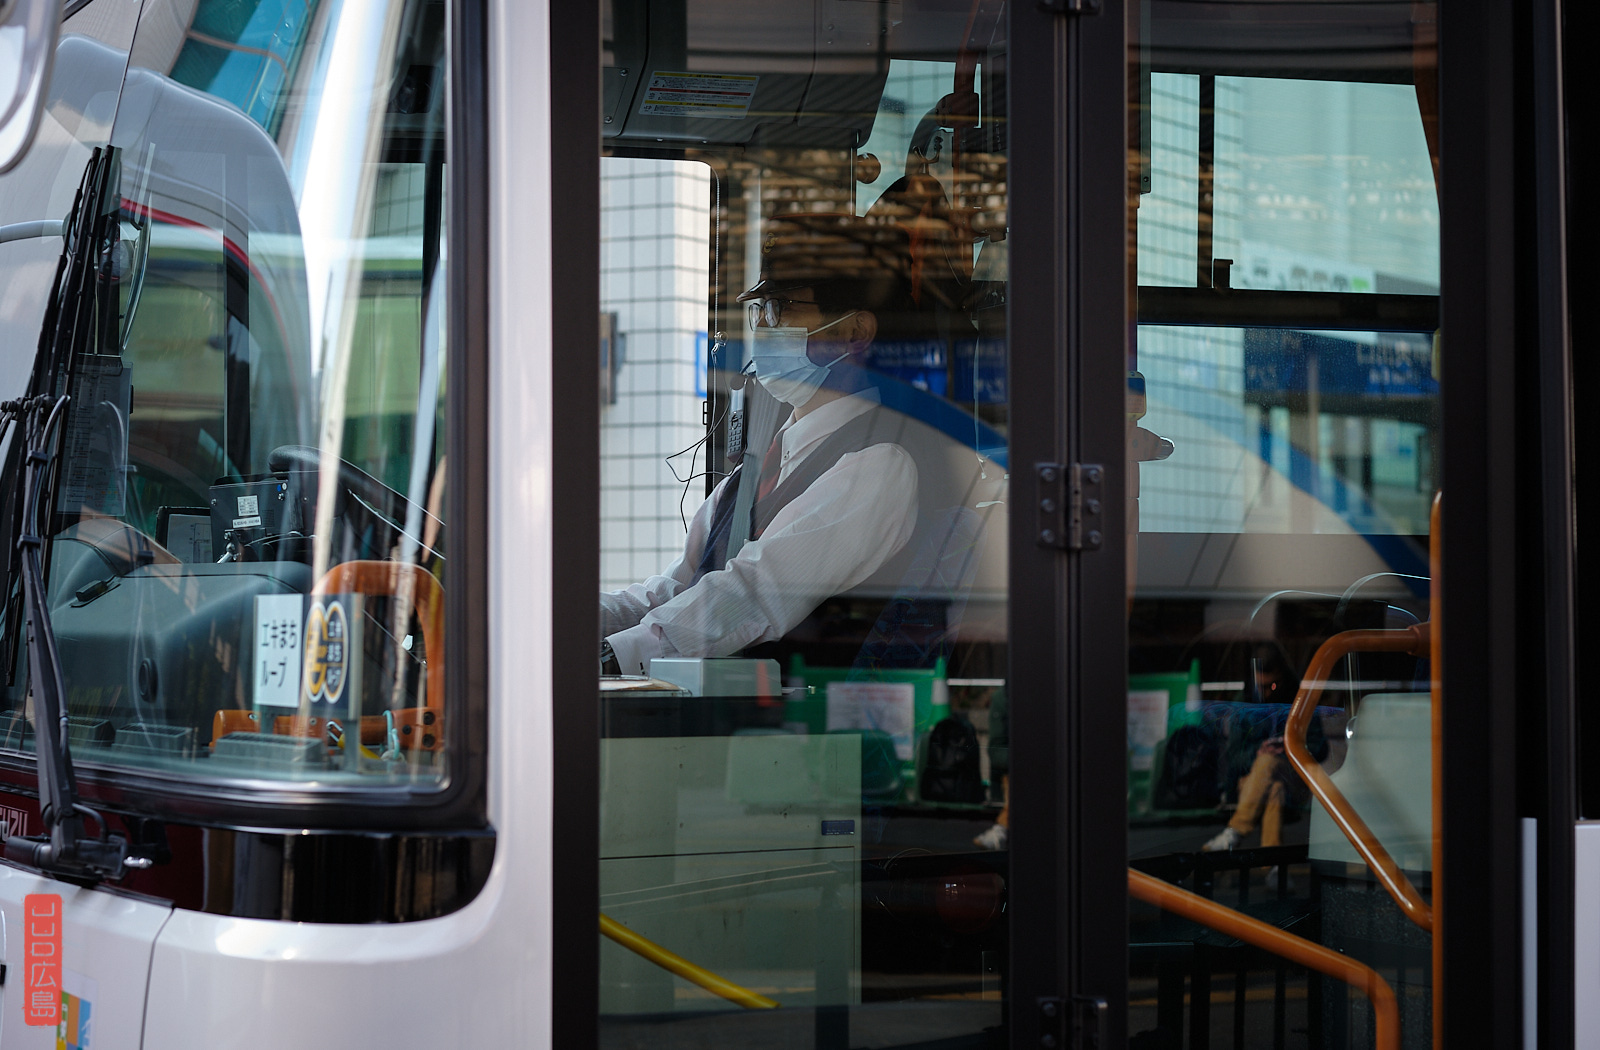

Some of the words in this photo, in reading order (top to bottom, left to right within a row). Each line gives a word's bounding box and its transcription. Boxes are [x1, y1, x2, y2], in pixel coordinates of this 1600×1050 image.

[262, 619, 297, 649] エキまち
[261, 656, 287, 687] ループ
[0, 805, 28, 839] UZU
